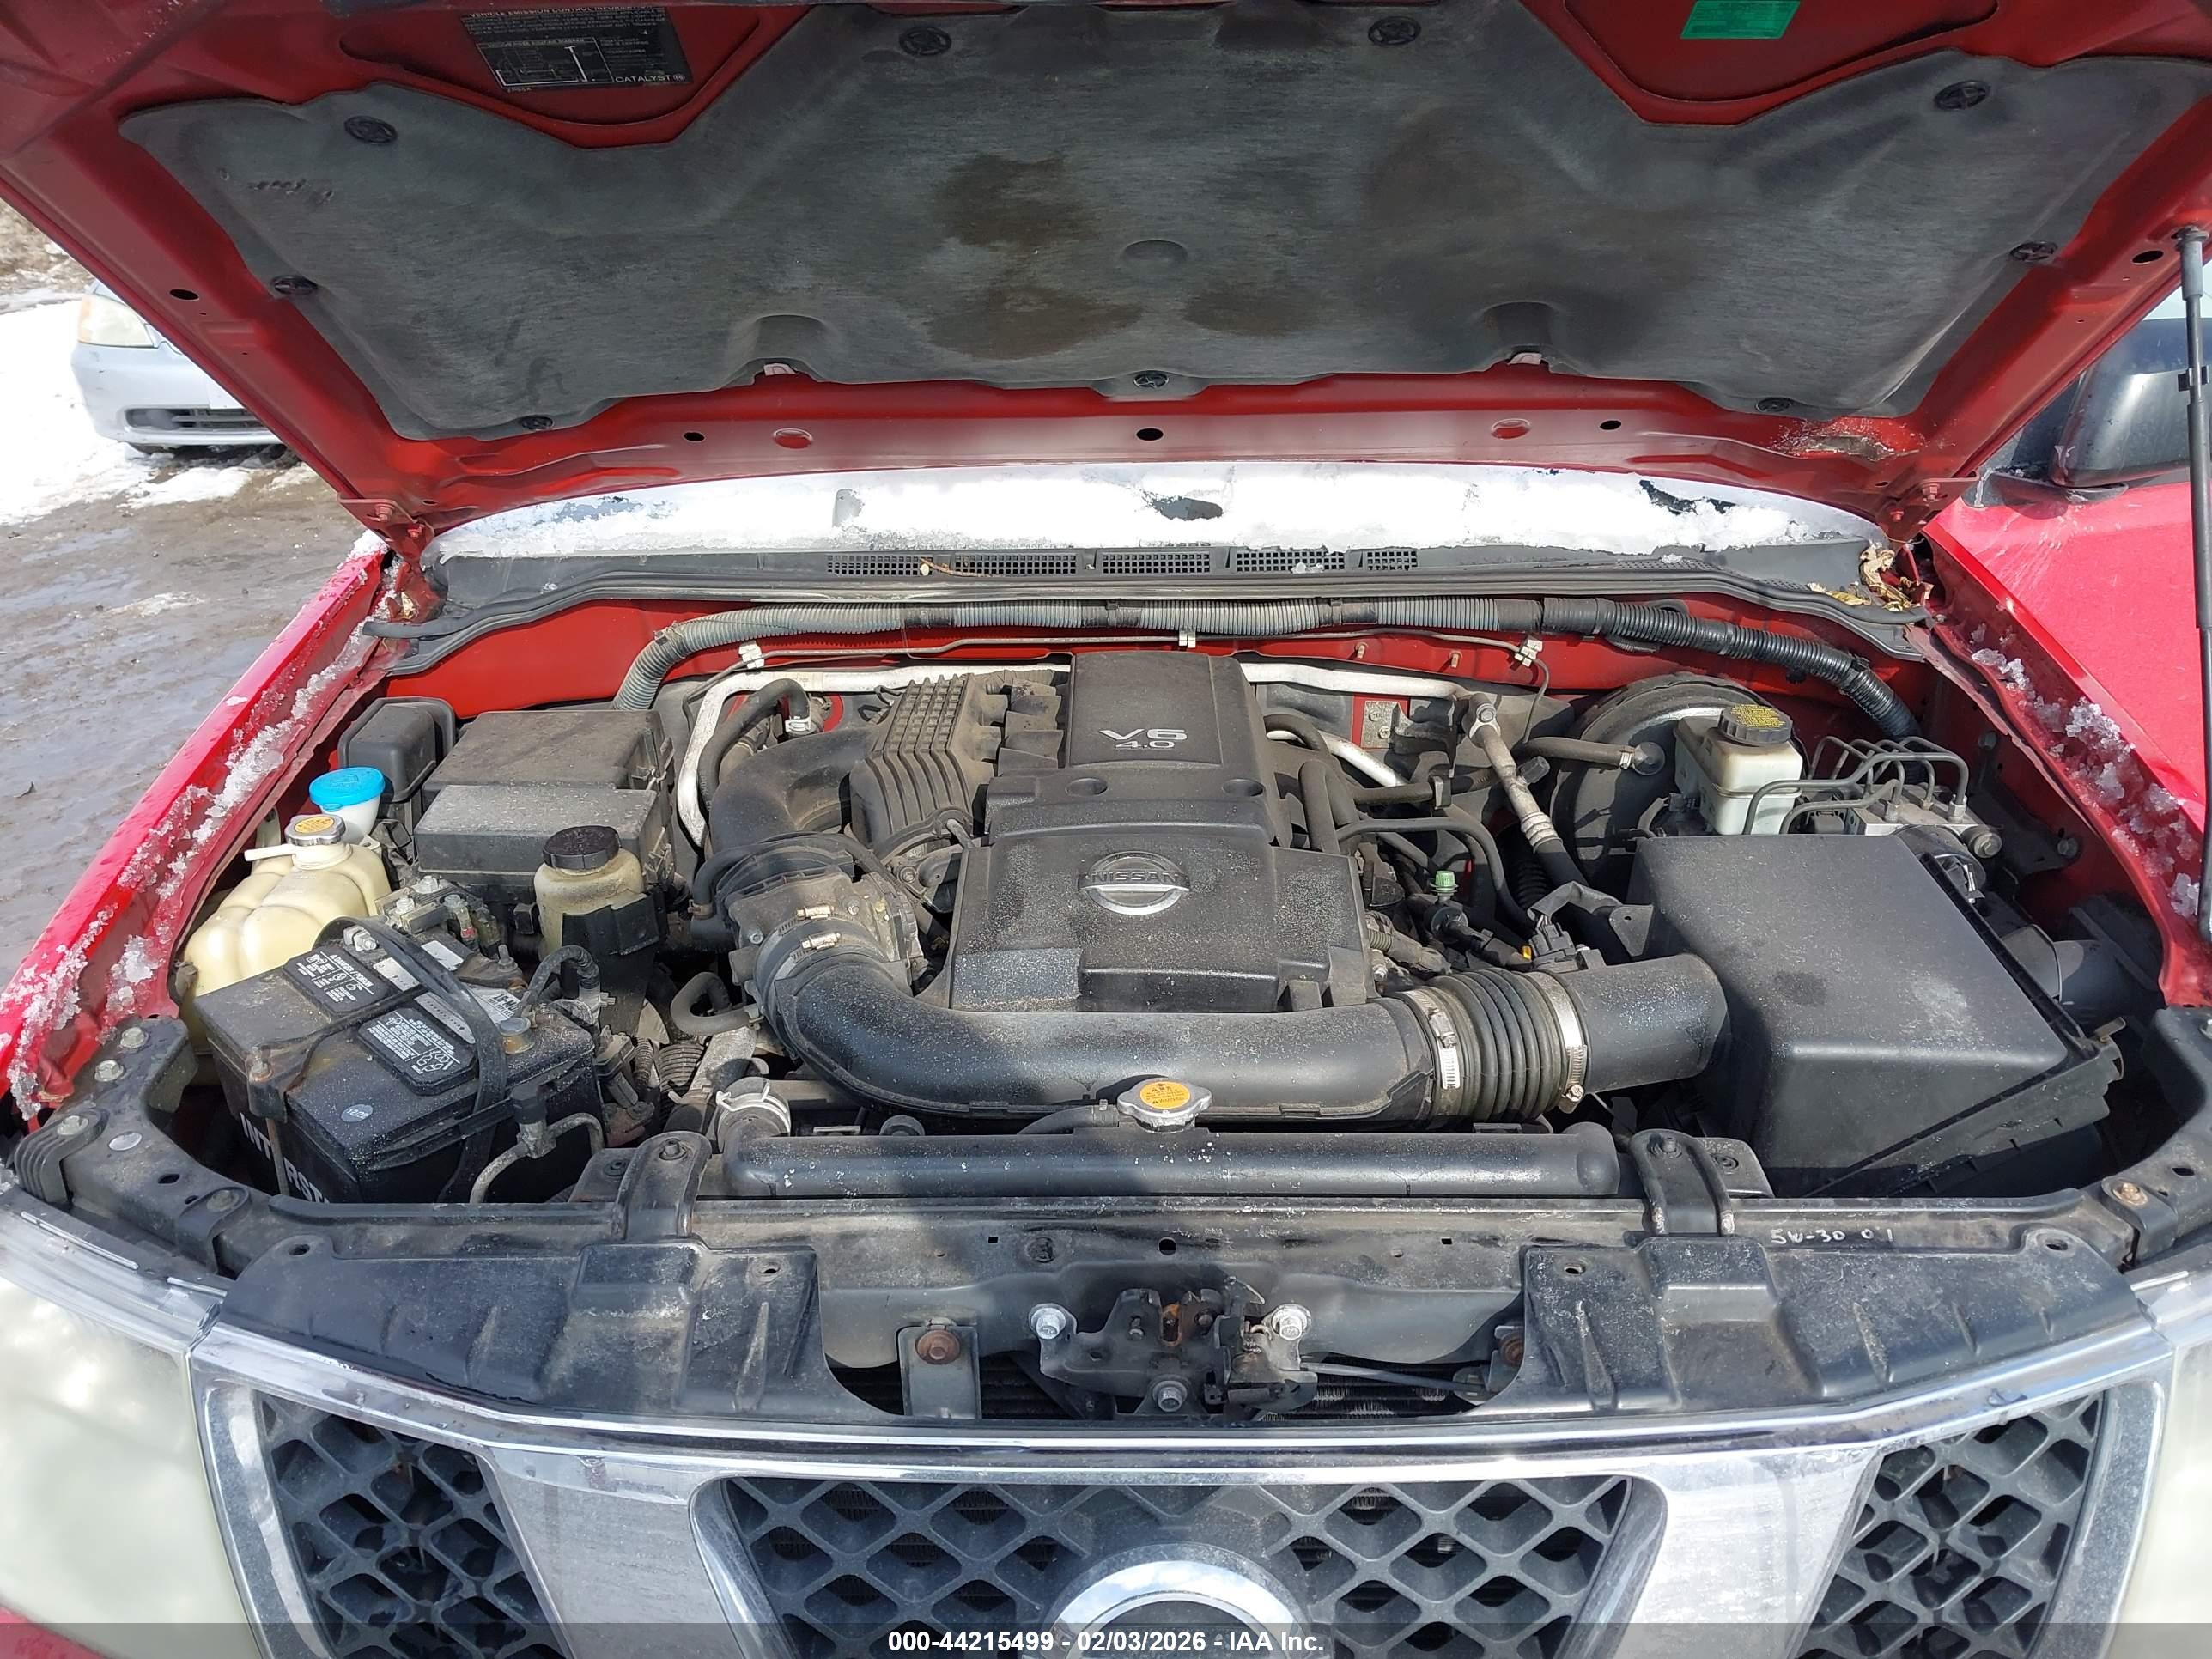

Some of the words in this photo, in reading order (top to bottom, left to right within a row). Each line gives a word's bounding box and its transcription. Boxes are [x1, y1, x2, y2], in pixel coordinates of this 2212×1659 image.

[1099, 728, 1188, 740] V6
[1114, 740, 1175, 749] 4.0
[1091, 871, 1179, 882] NISSAN
[1770, 1229, 1846, 1244] 5W-30
